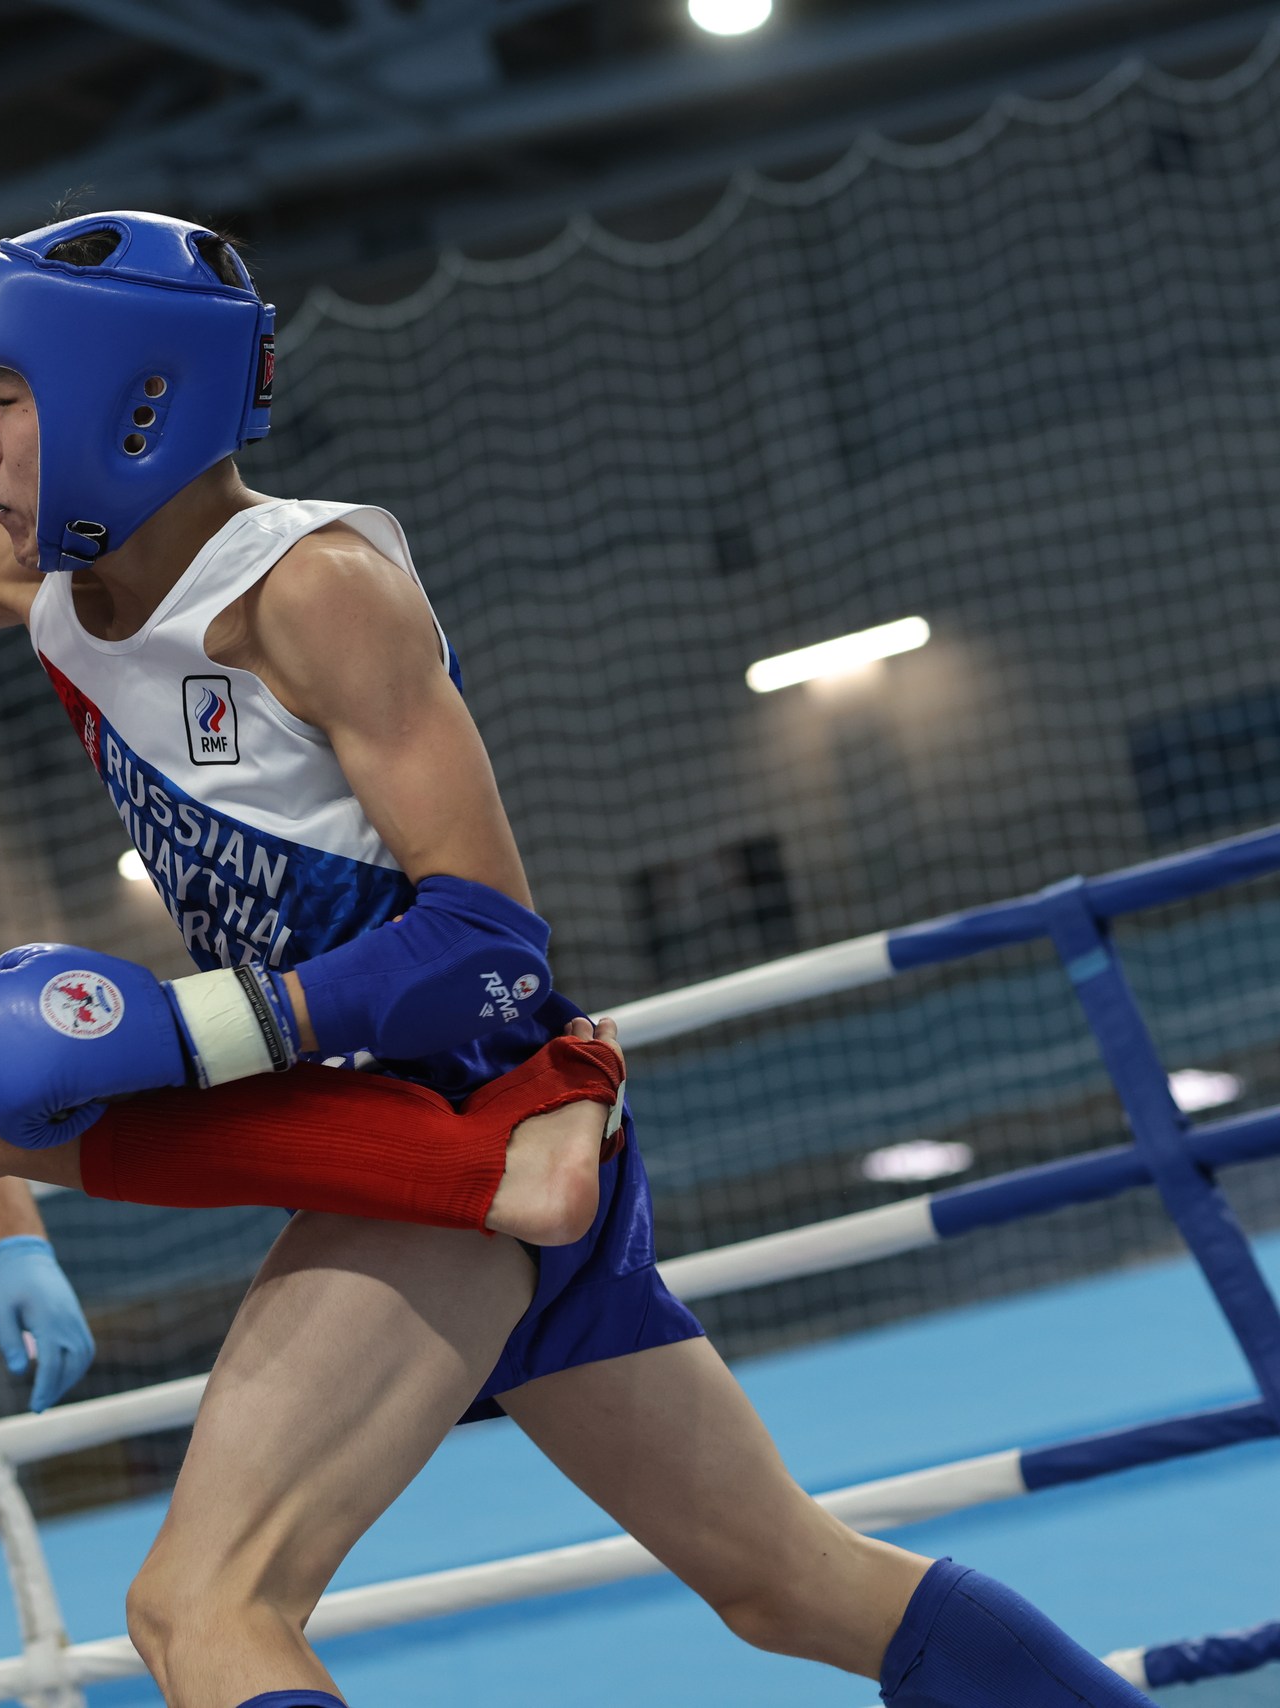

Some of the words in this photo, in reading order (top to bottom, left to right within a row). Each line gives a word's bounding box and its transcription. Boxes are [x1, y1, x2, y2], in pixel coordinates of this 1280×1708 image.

[106, 733, 288, 899] RUSSIAN
[201, 736, 228, 753] RMF
[108, 781, 292, 967] MUAYTHAI
